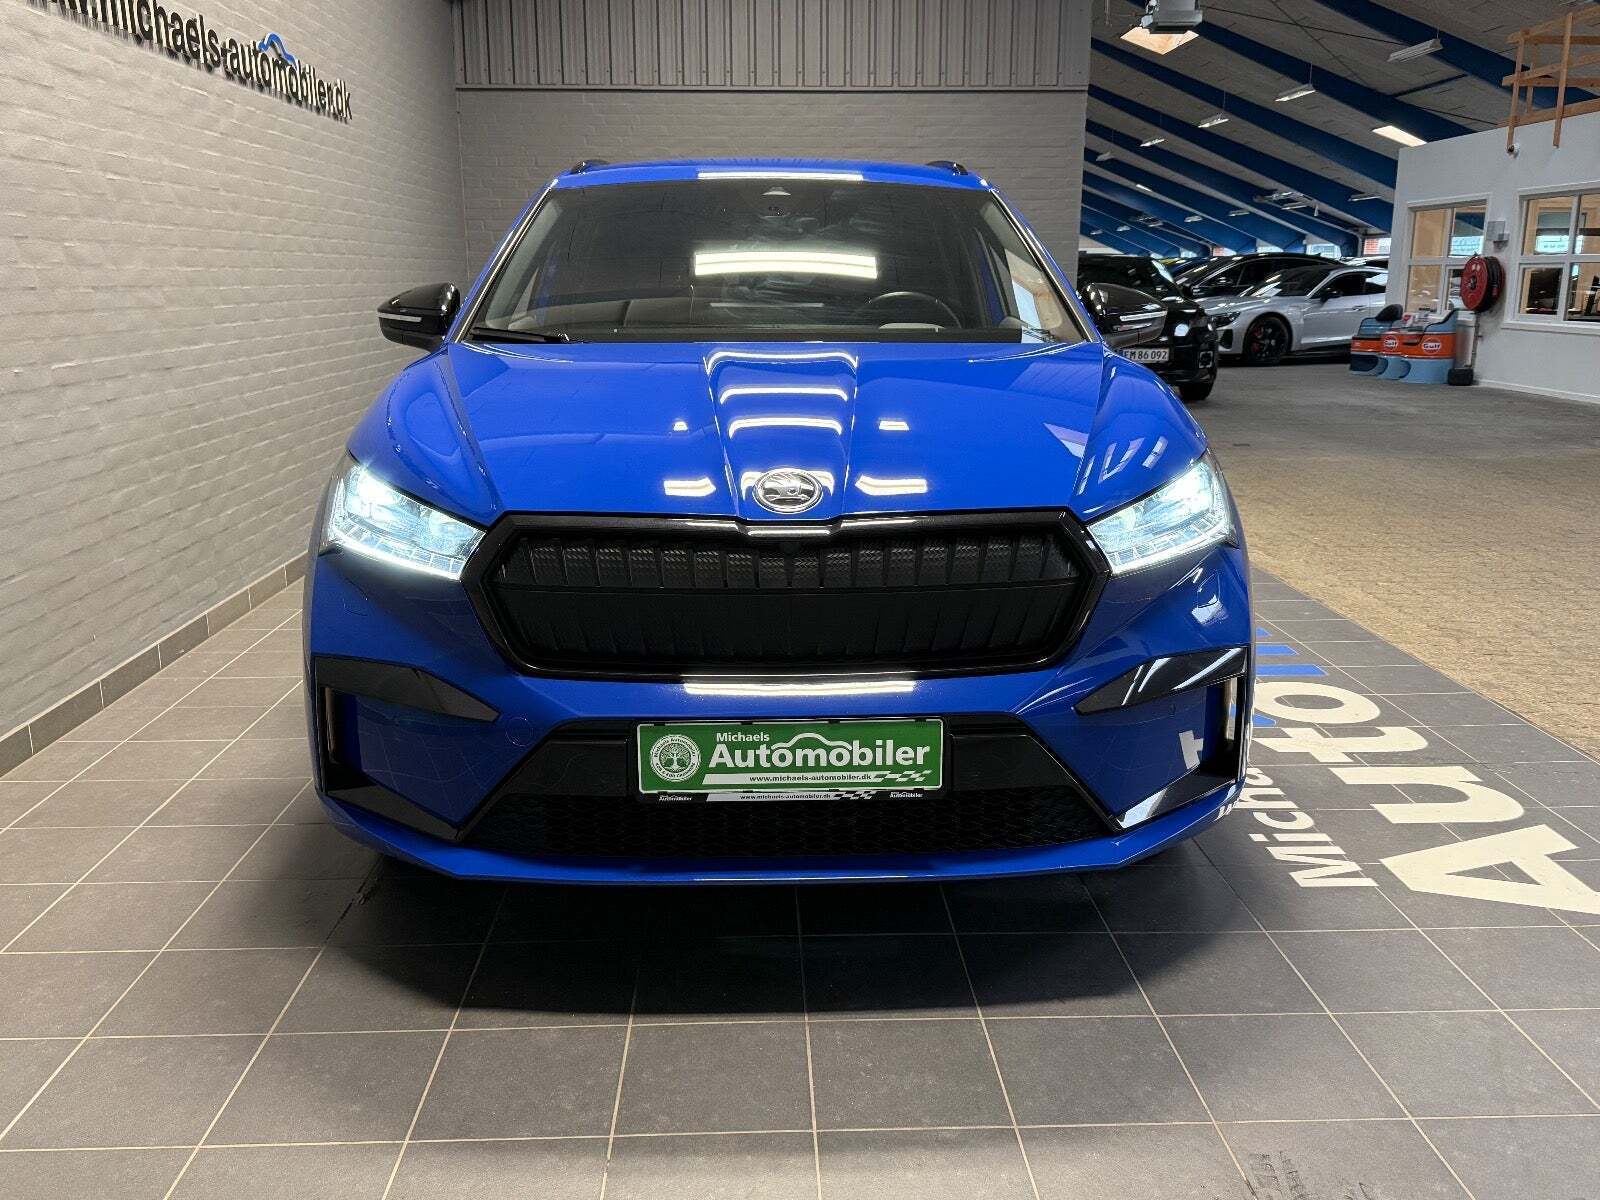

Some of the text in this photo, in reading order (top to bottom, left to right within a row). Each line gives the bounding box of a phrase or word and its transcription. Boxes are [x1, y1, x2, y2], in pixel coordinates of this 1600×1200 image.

[1137, 350, 1149, 360] 86
[1150, 350, 1167, 360] 092
[716, 732, 770, 742] Michaels
[708, 739, 931, 768] Automobiler
[749, 774, 872, 782] www.michaels-automobiler.dk
[1233, 767, 1379, 887] Micha
